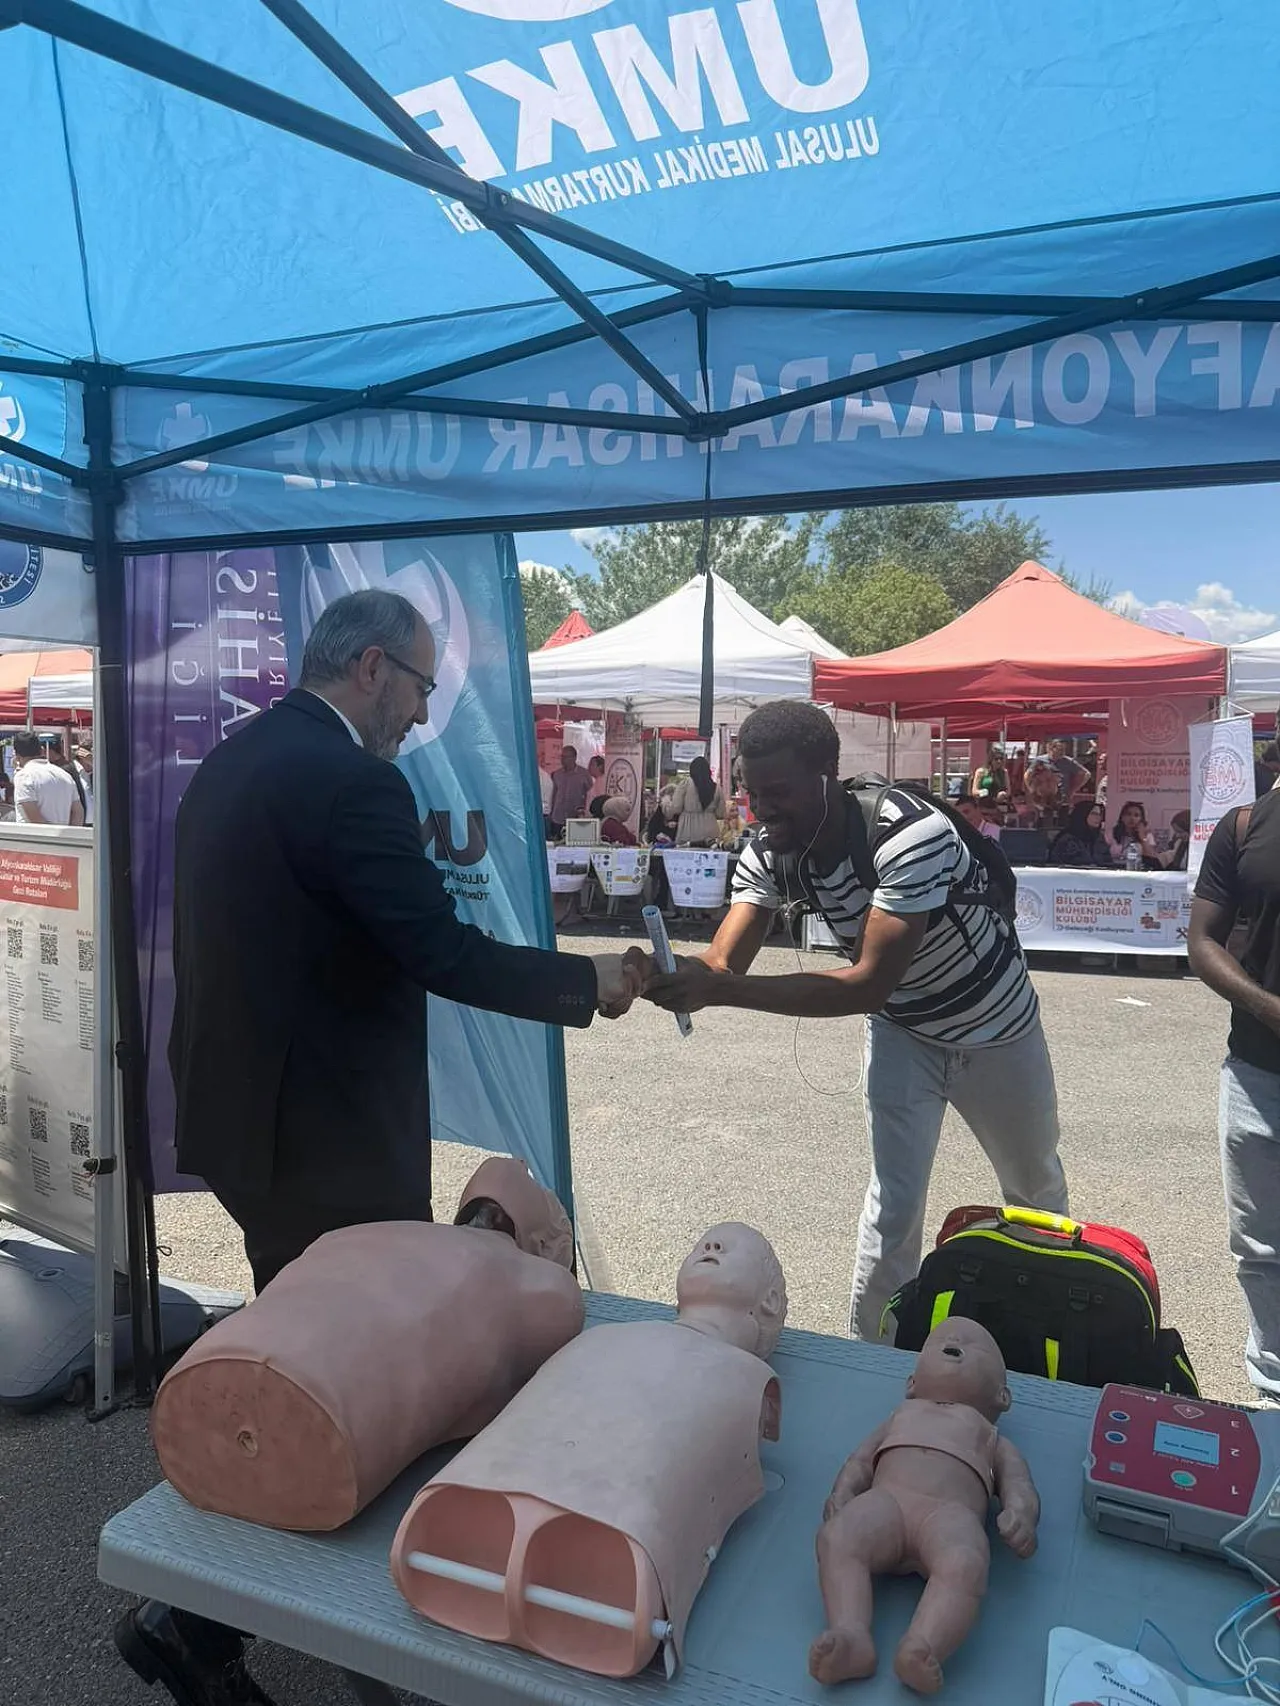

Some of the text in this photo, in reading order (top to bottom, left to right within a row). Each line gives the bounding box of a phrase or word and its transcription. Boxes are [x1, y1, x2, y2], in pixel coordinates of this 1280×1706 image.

[1120, 768, 1190, 777] MÜHENDİSLİĞ
[1055, 895, 1132, 906] BİLGİSAYAR
[1055, 905, 1132, 916] MÜHENDİSLİĞİ
[1055, 914, 1097, 924] KULÜBÜ
[1230, 1448, 1240, 1457] 2
[1230, 1485, 1239, 1495] 1
